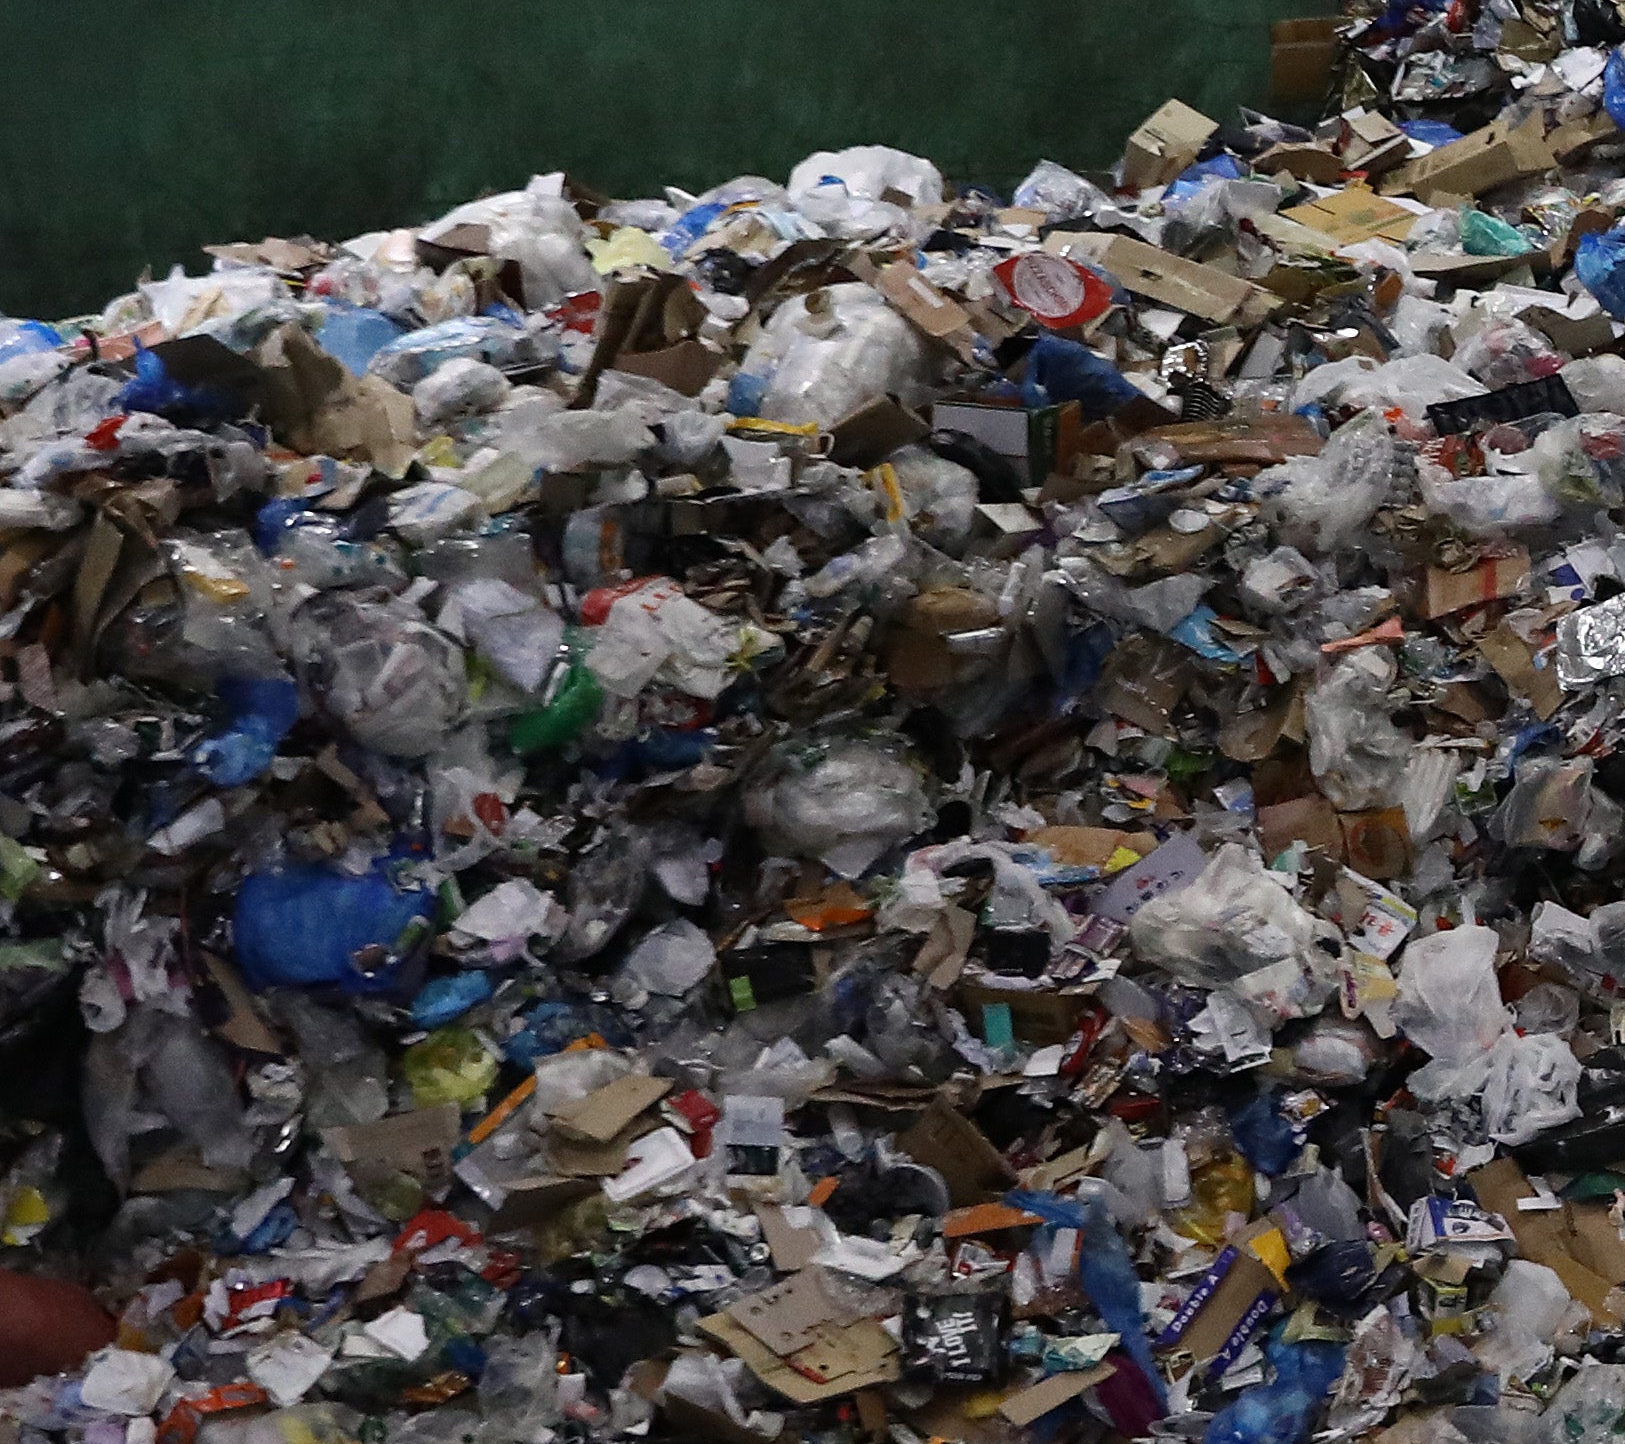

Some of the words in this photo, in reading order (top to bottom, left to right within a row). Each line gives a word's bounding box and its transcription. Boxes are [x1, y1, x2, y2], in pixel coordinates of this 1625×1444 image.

[1168, 1286, 1208, 1334] Double
[1204, 1271, 1220, 1288] A
[1227, 1298, 1271, 1345] Double
[1218, 1342, 1237, 1361] A
